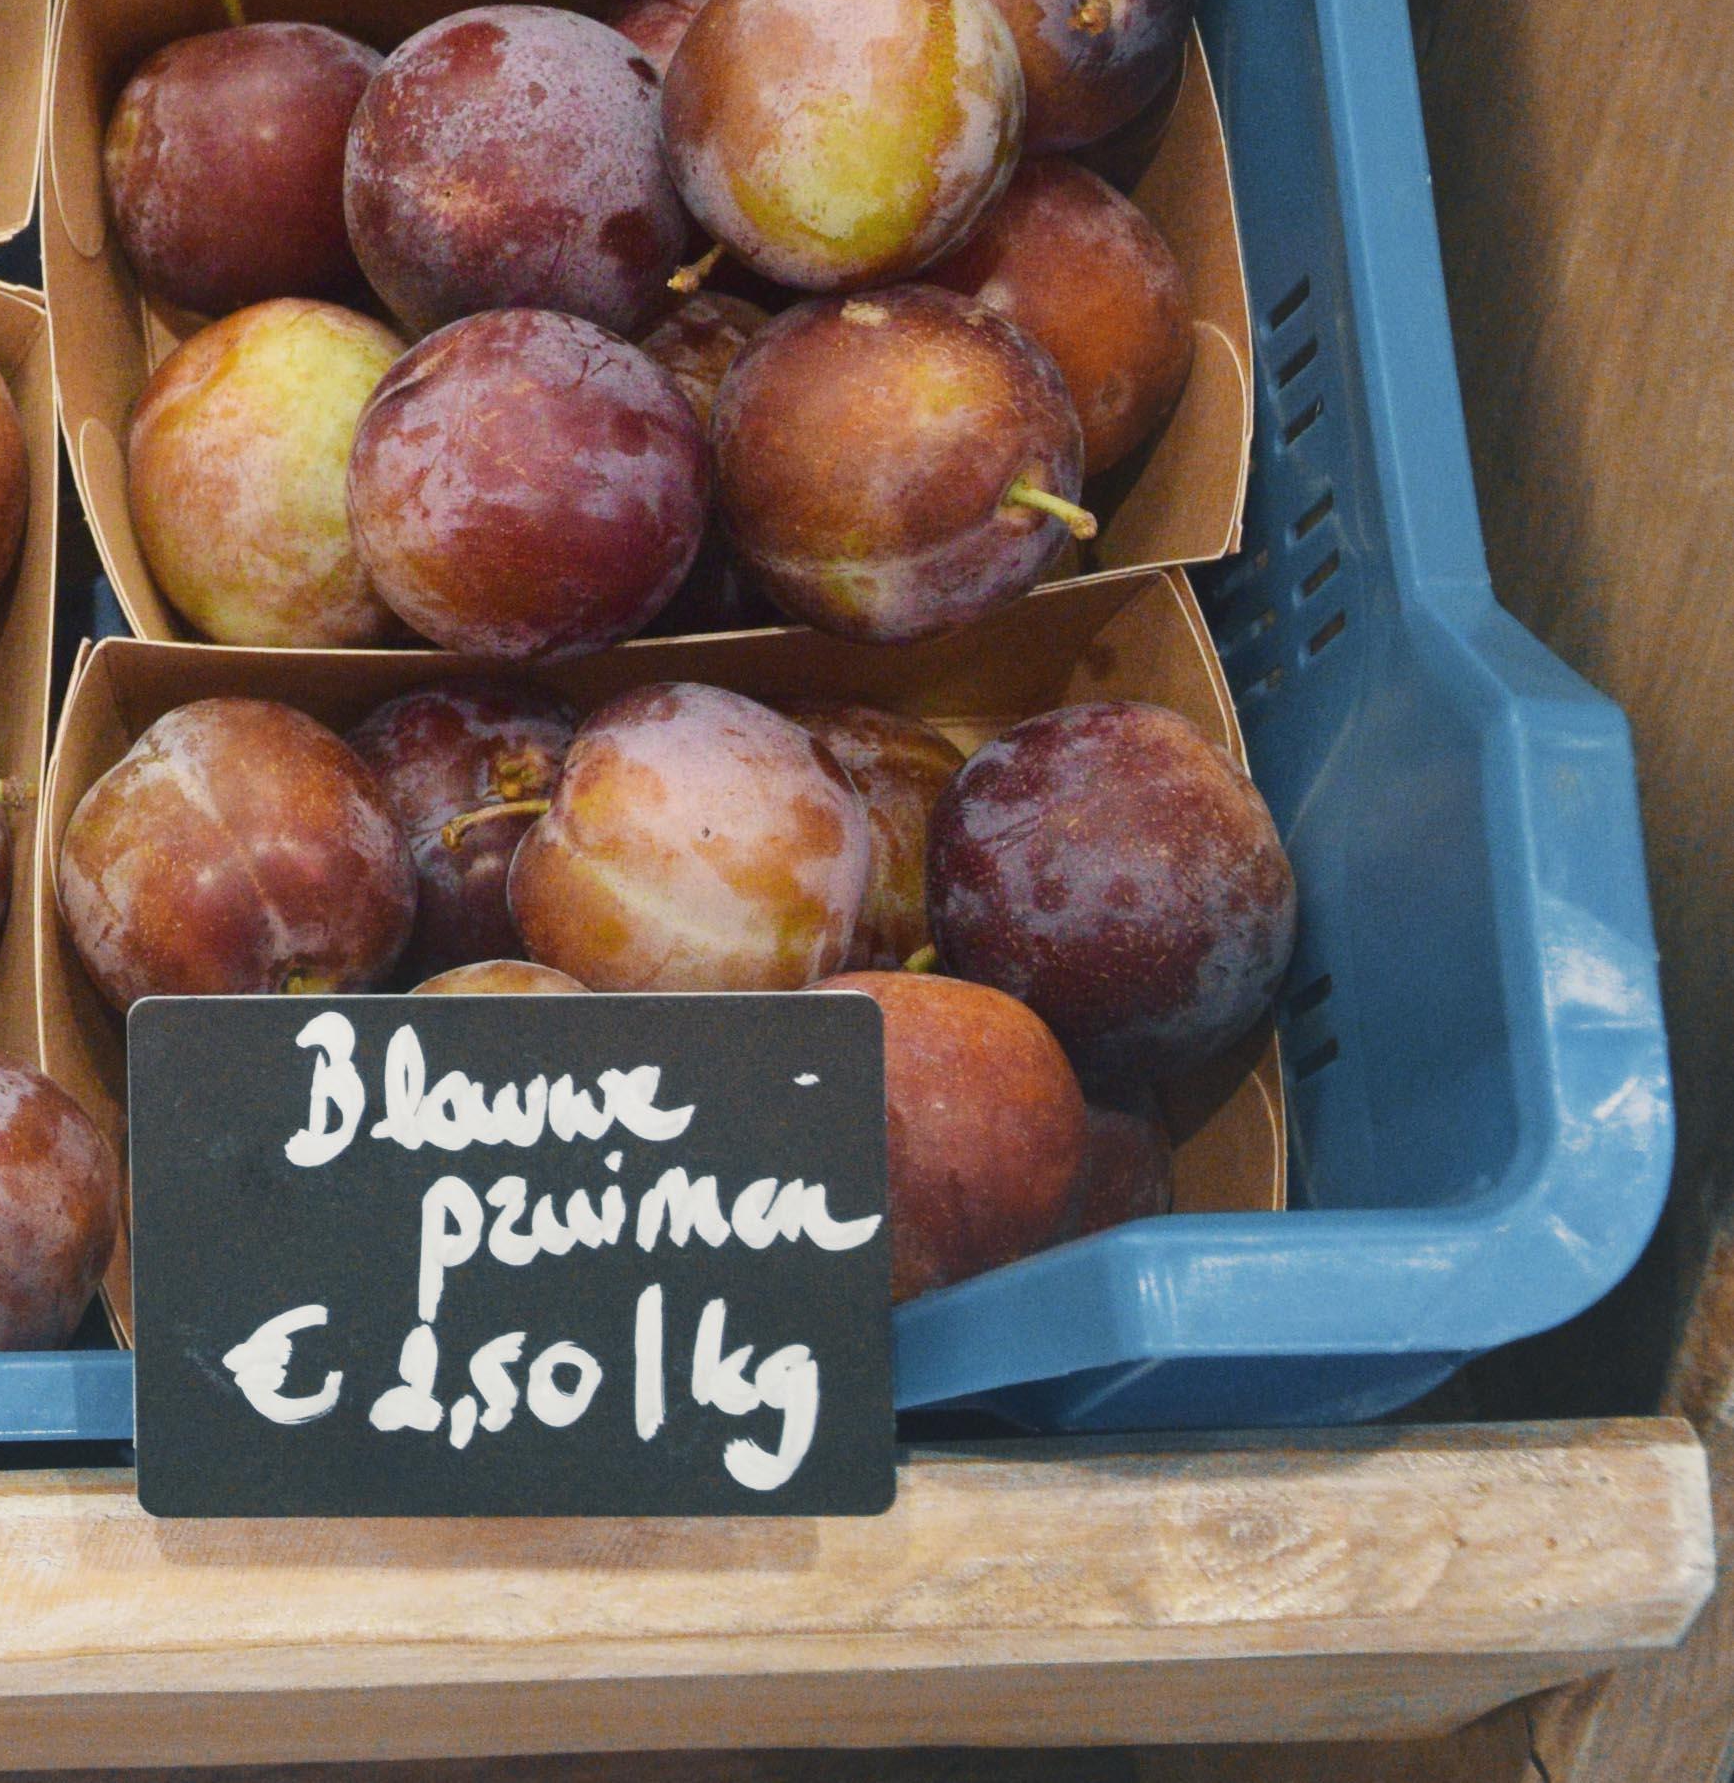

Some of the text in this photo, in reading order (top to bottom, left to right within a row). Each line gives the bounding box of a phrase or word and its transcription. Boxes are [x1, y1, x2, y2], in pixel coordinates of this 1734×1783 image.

[285, 1012, 695, 1167] Blauwe
[419, 1151, 883, 1324] pruimen
[222, 1305, 344, 1425] €
